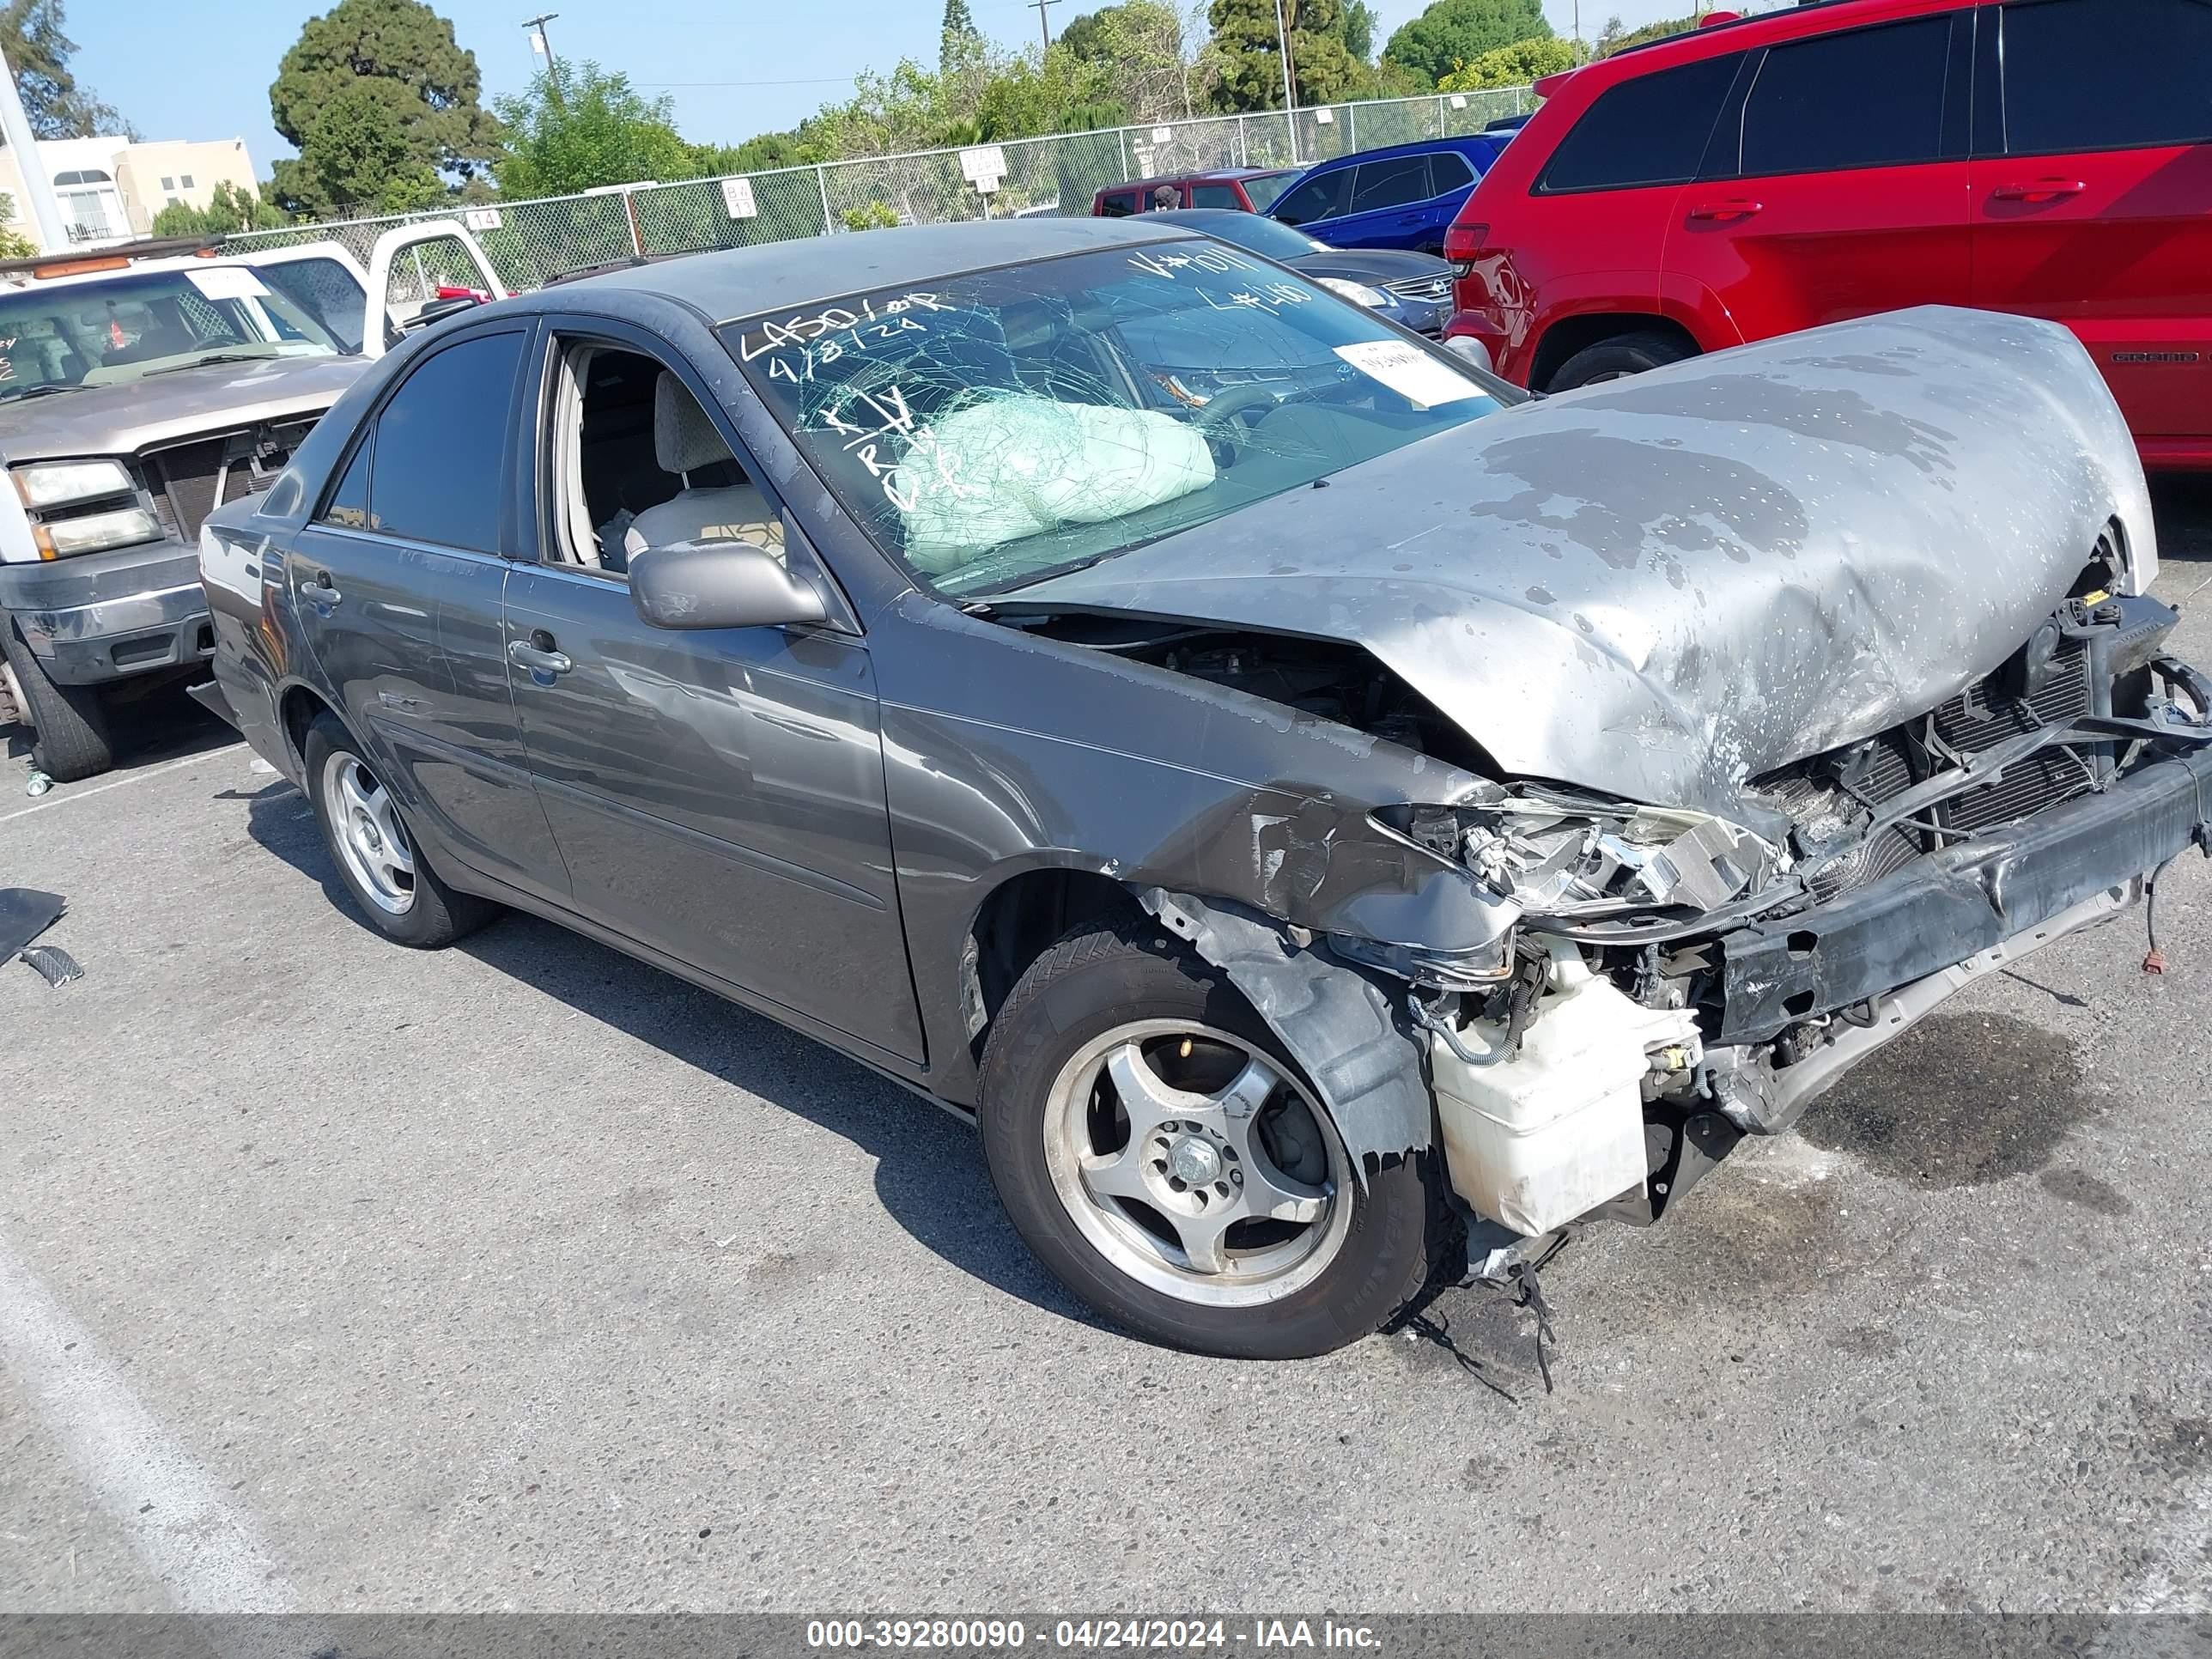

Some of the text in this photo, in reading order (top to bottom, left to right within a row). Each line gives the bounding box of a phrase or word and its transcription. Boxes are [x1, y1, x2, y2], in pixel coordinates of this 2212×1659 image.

[981, 177, 996, 190] 12
[735, 202, 752, 216] 13
[474, 212, 495, 228] 14
[2112, 352, 2199, 362] GRAND
